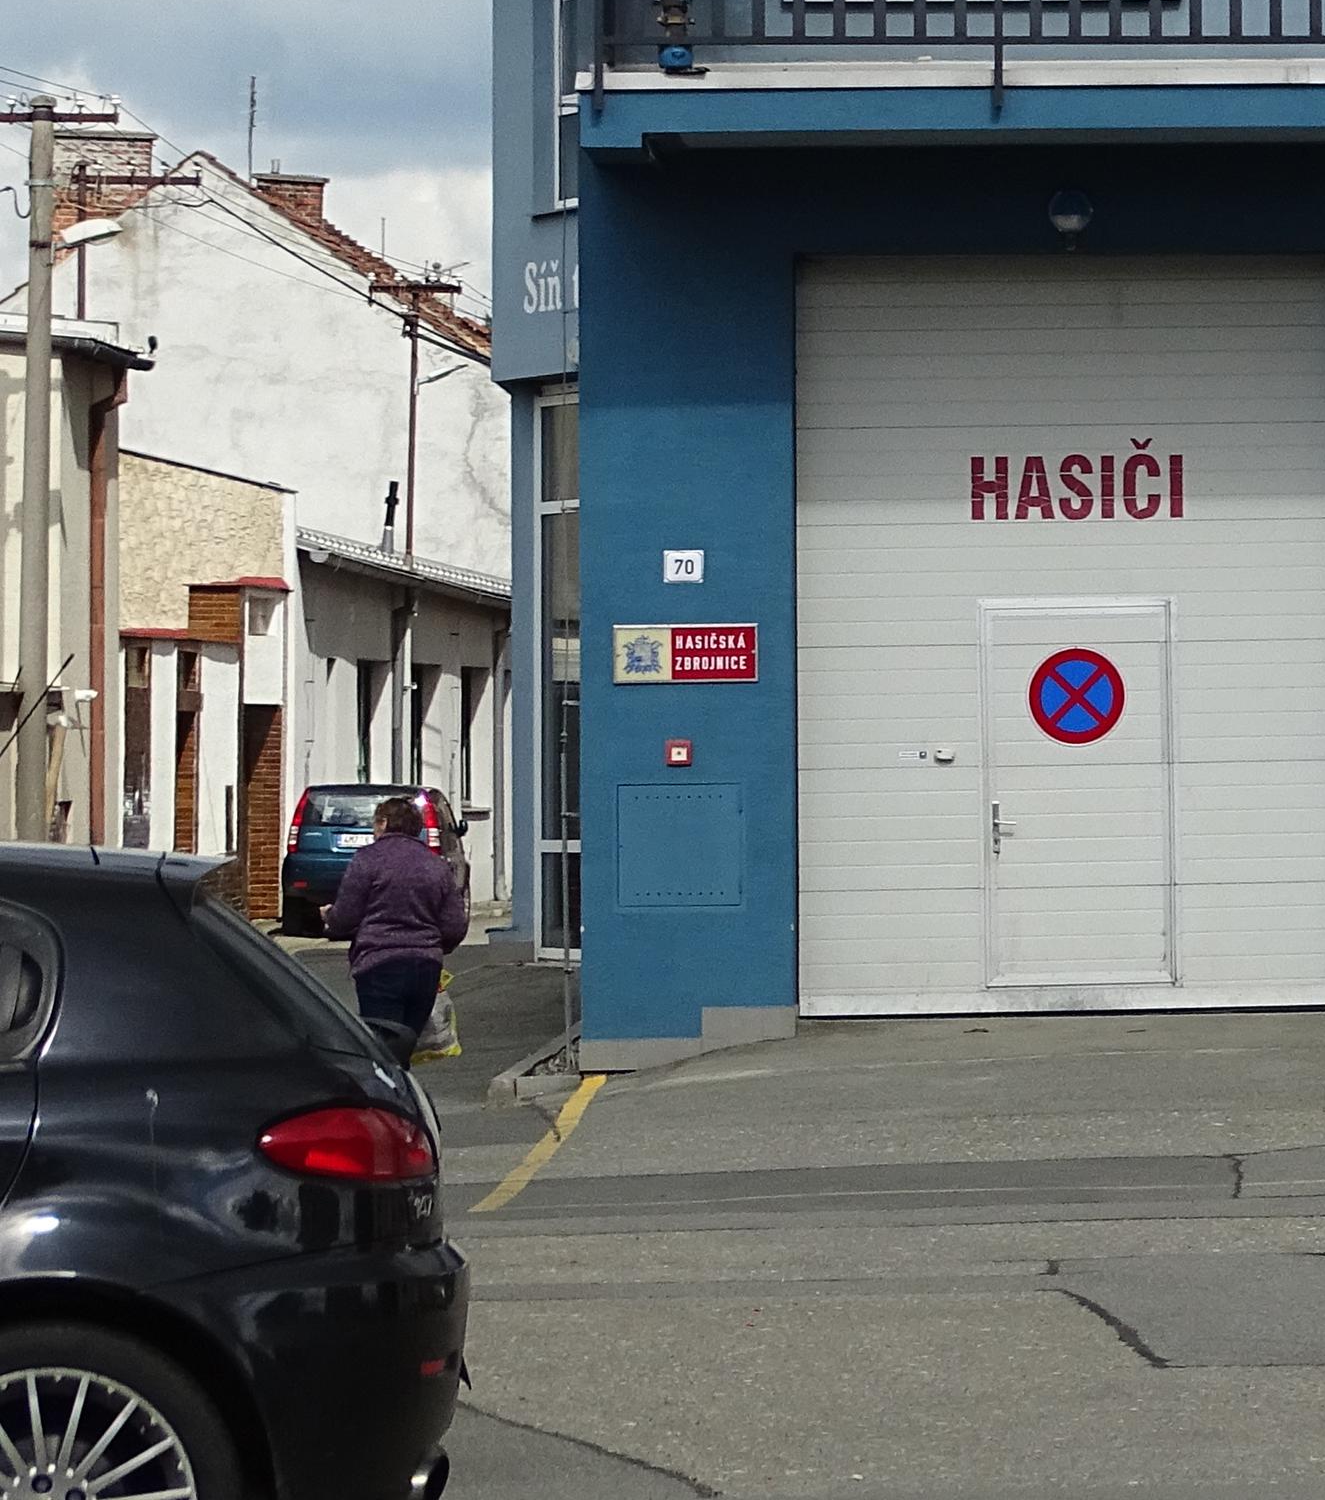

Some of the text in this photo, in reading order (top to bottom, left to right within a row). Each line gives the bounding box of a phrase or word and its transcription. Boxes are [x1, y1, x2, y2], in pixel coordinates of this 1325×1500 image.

[970, 437, 1184, 521] HASIČI
[674, 559, 695, 575] 70
[675, 632, 747, 649] HASIČSKÁ
[675, 655, 748, 671] ZBROJNICE
